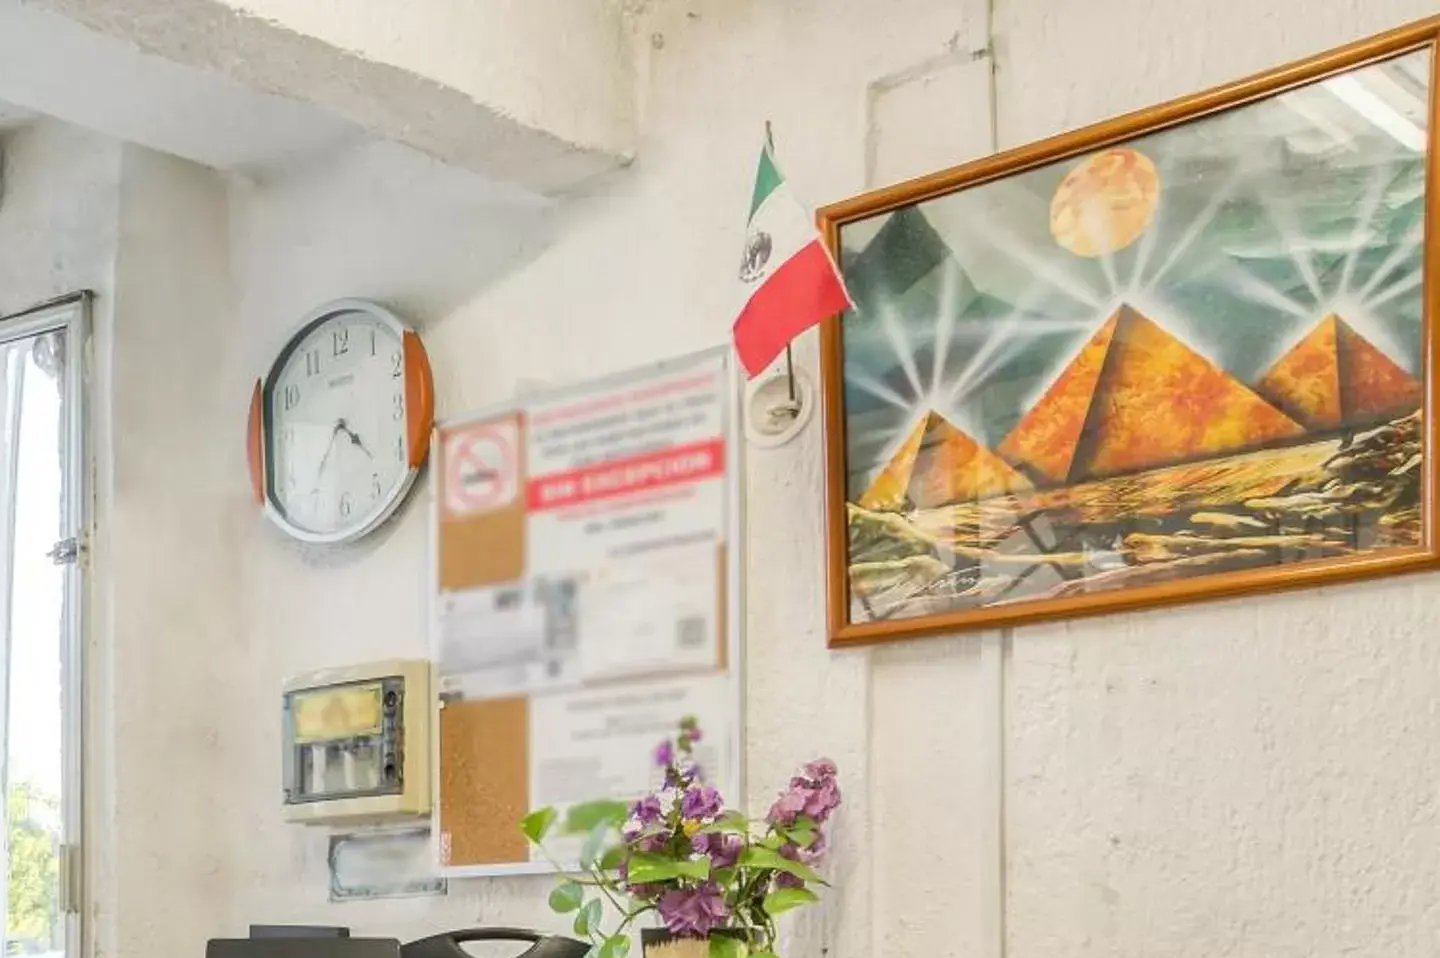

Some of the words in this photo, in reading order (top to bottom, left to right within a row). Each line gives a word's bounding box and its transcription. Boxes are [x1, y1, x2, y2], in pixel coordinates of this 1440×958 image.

[333, 328, 349, 356] 12
[370, 330, 376, 356] 1
[306, 350, 320, 377] 11
[392, 352, 402, 379] 2
[285, 384, 300, 411] 10
[392, 393, 404, 421] 3
[371, 471, 382, 501] 5
[339, 491, 351, 519] 6
